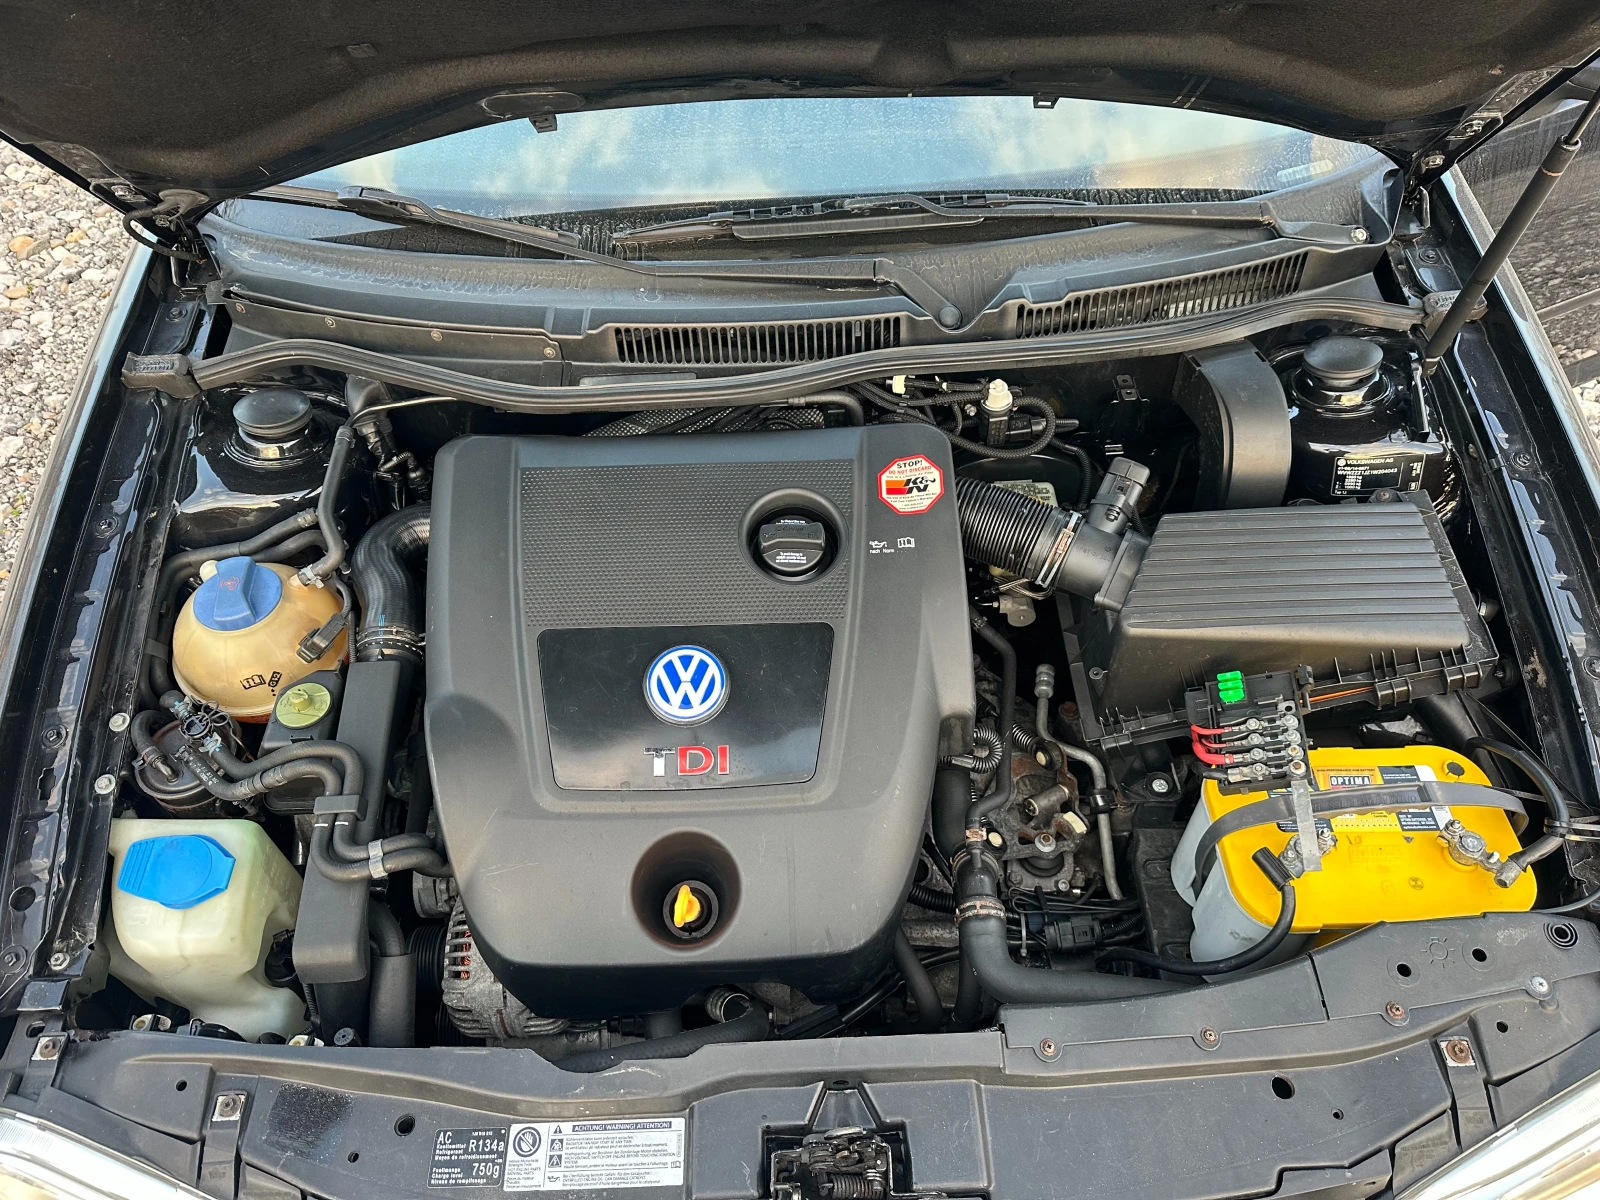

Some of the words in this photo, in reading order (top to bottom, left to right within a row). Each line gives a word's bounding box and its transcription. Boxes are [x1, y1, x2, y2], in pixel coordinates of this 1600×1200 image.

[897, 460, 922, 469] STOP!
[644, 745, 729, 776] TDI
[1331, 776, 1370, 785] OPTIMA
[437, 1131, 452, 1144] AC
[468, 1139, 504, 1152] R134a
[472, 1162, 499, 1178] 750g
